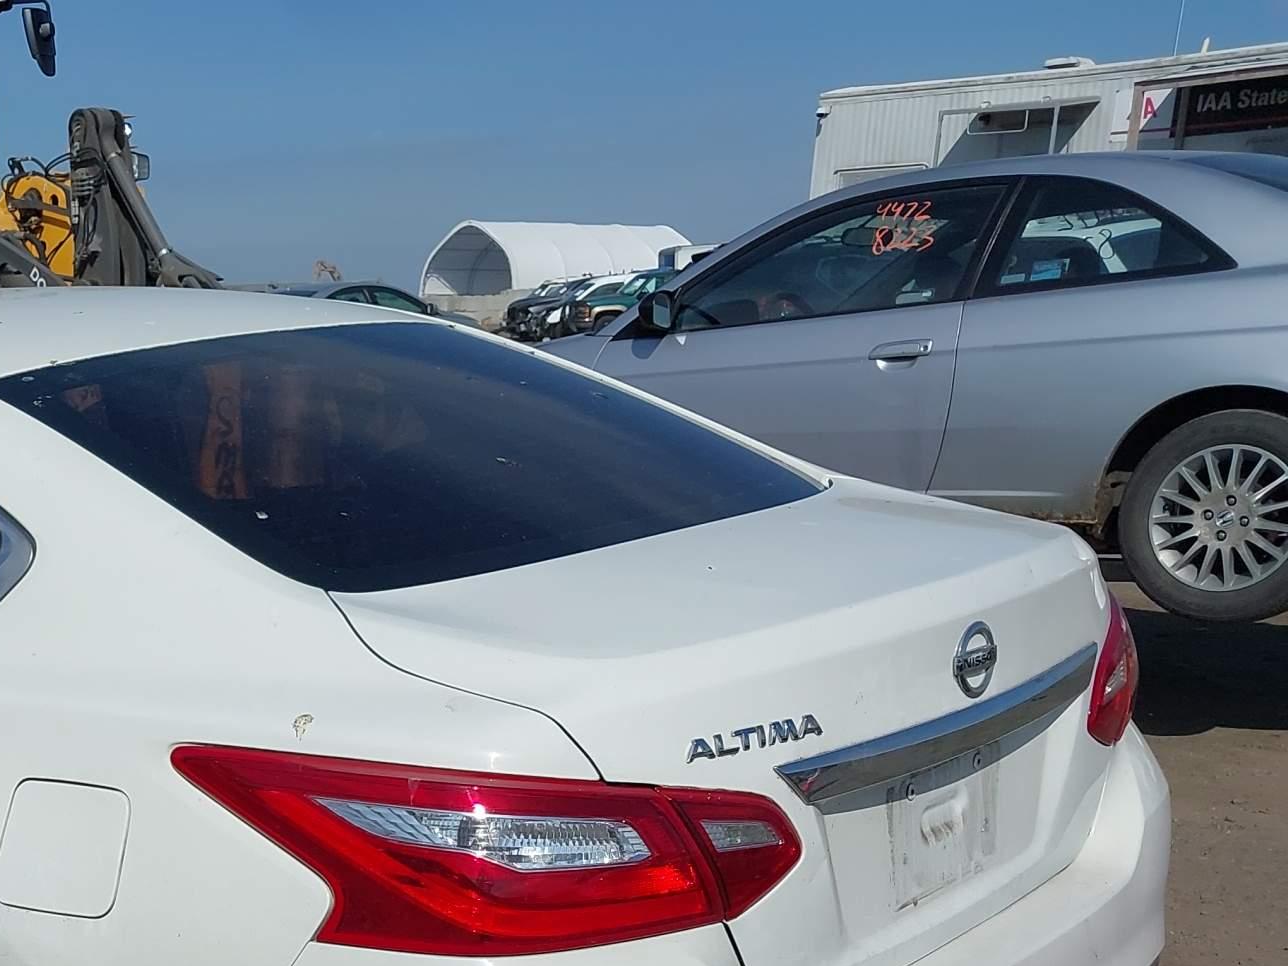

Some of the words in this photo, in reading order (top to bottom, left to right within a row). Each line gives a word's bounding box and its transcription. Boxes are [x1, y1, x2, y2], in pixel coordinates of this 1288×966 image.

[1196, 91, 1232, 112] IAA
[1237, 87, 1288, 109] State
[876, 201, 932, 221] 4472
[686, 713, 824, 764] ALTIMA
